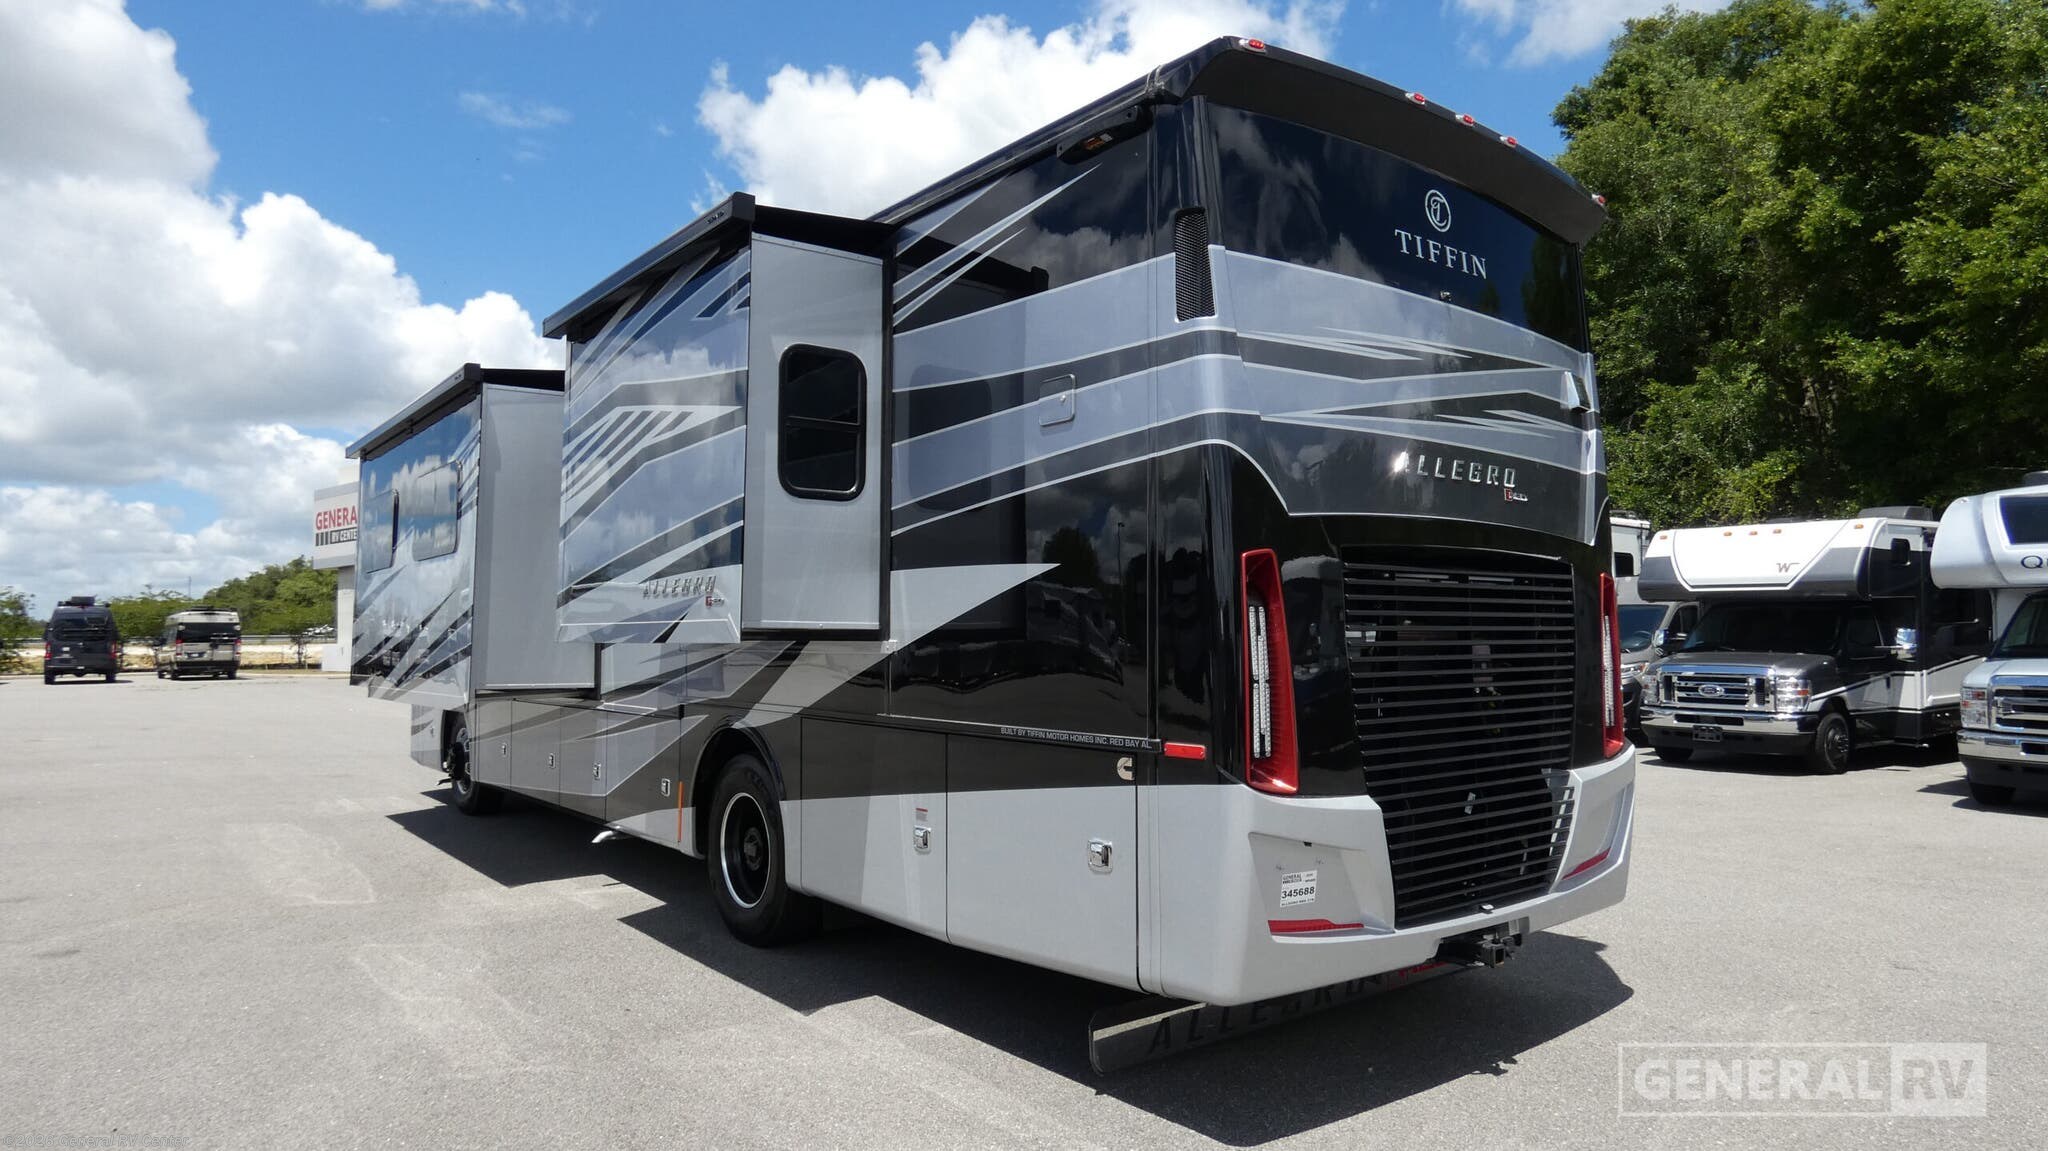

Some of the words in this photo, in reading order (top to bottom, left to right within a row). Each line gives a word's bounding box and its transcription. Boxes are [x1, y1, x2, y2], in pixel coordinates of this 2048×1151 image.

[1395, 229, 1486, 279] TIFFIN
[316, 505, 357, 530] GENERA
[2021, 555, 2048, 570] Q
[1000, 727, 1016, 735] BUILT
[1027, 730, 1045, 739] TIFFIN
[1046, 732, 1069, 741] MOTOR
[1070, 734, 1094, 743] HOMES
[1110, 738, 1124, 746] RED
[1125, 739, 1140, 747] BAY
[1281, 886, 1315, 899] 345688
